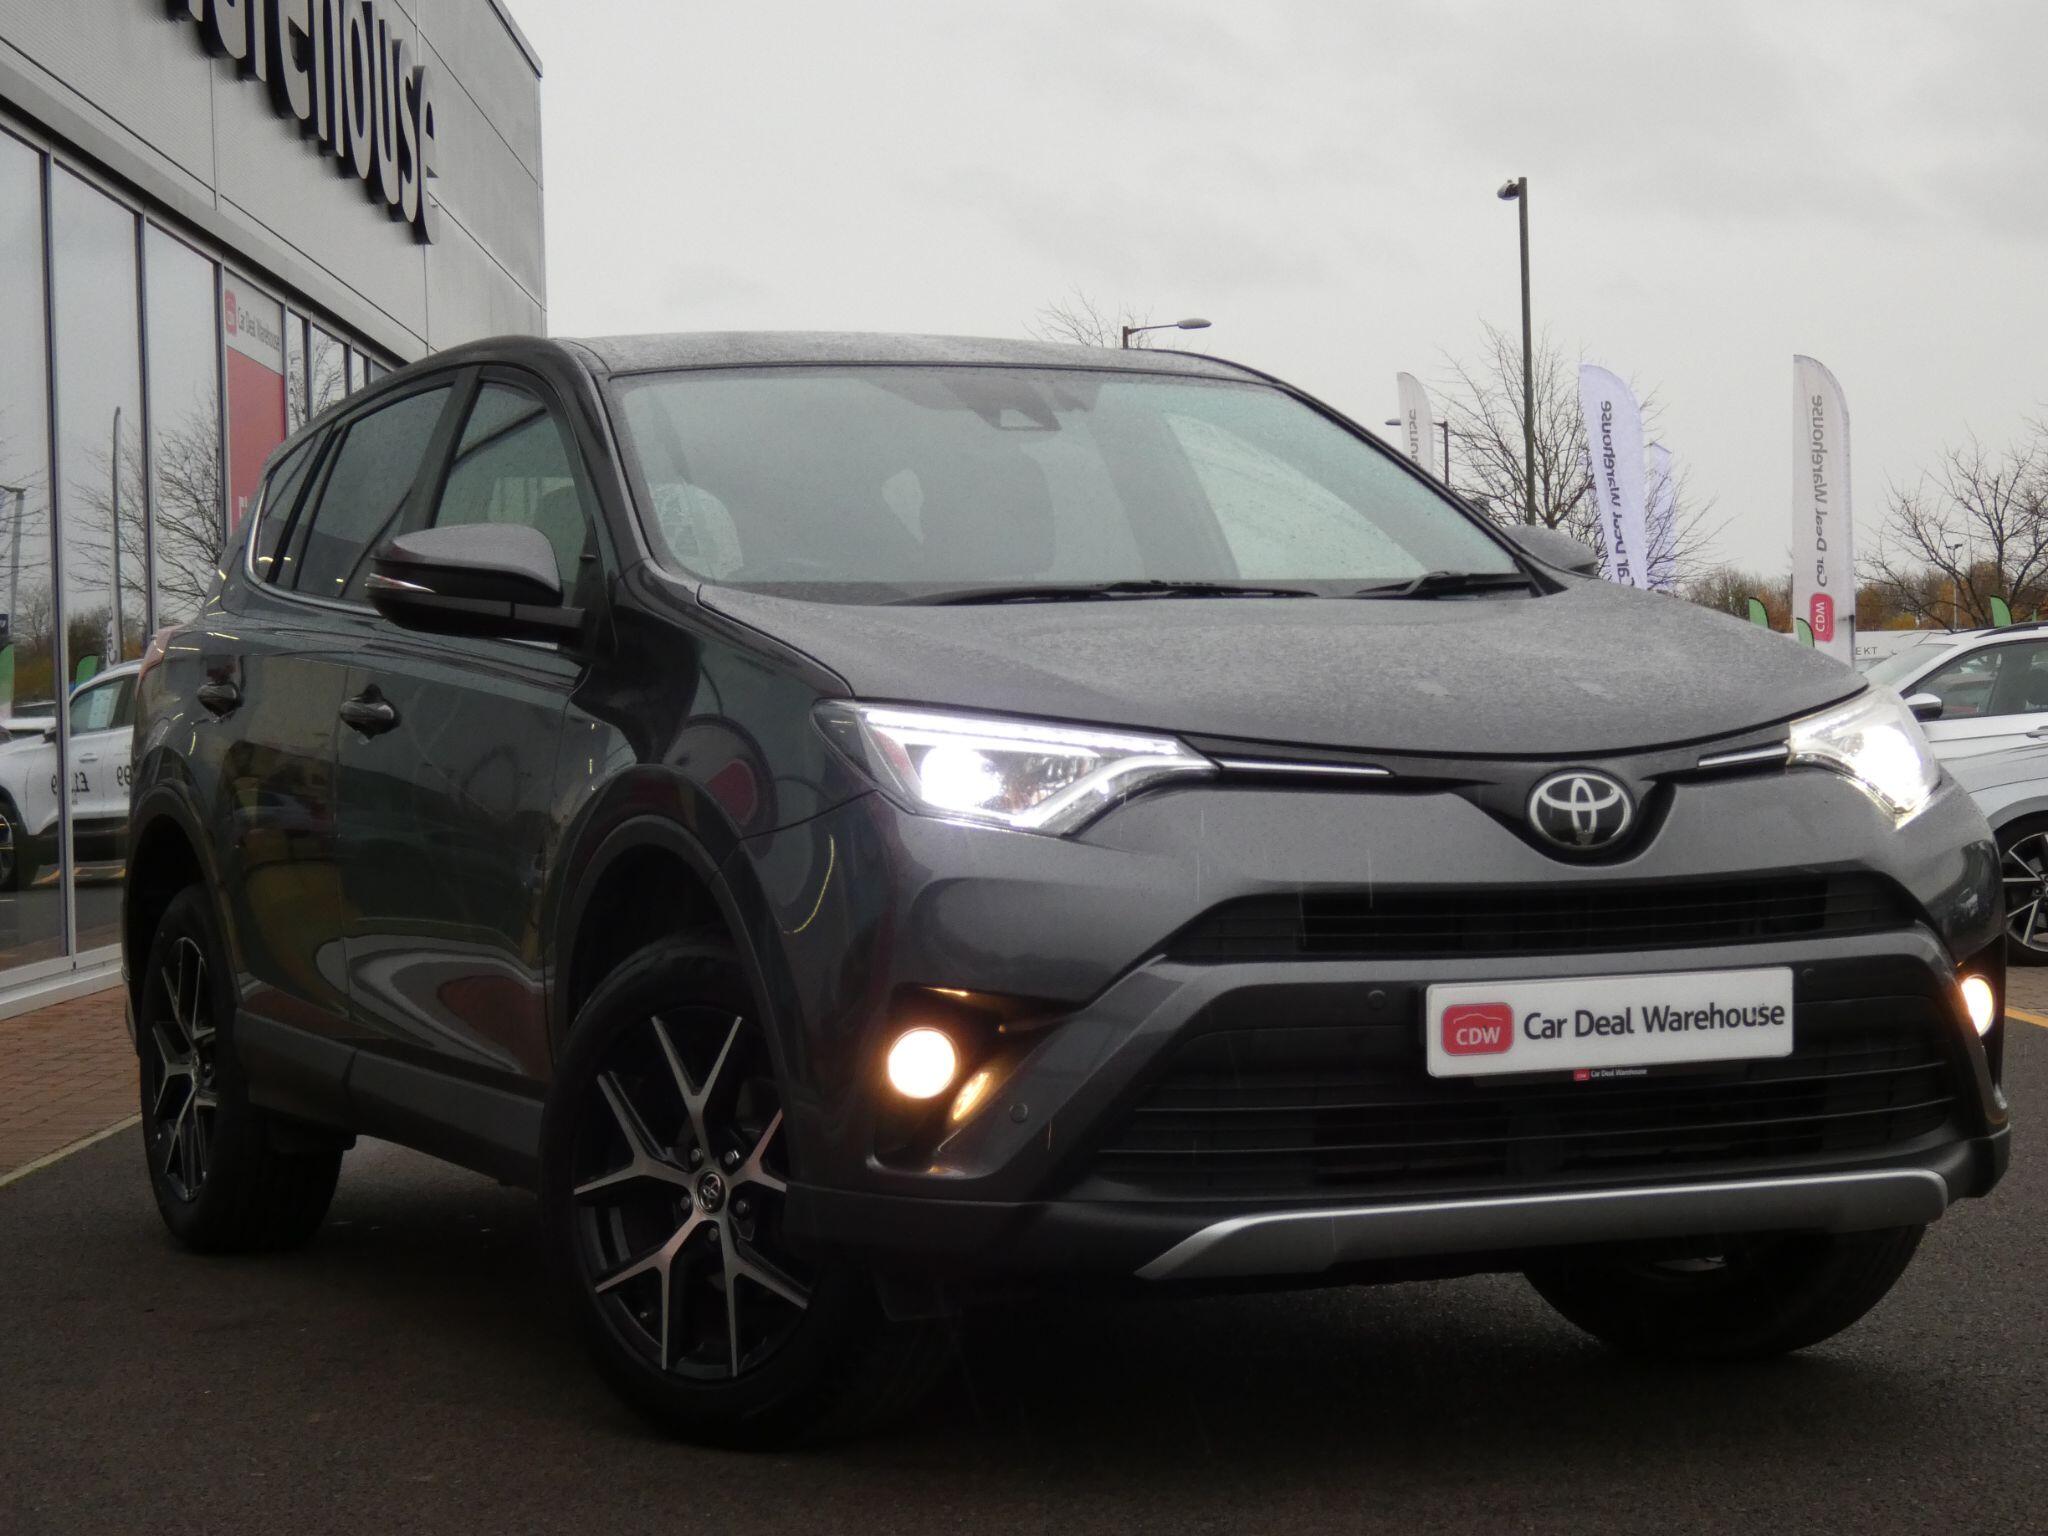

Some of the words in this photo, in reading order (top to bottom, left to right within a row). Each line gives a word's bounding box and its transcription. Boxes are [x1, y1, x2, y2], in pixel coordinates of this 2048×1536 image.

[165, 0, 440, 245] ehouse
[1455, 1026, 1501, 1046] CDW
[1523, 1012, 1568, 1041] Car
[1574, 1006, 1635, 1038] Deal
[1641, 1001, 1786, 1034] Warehouse
